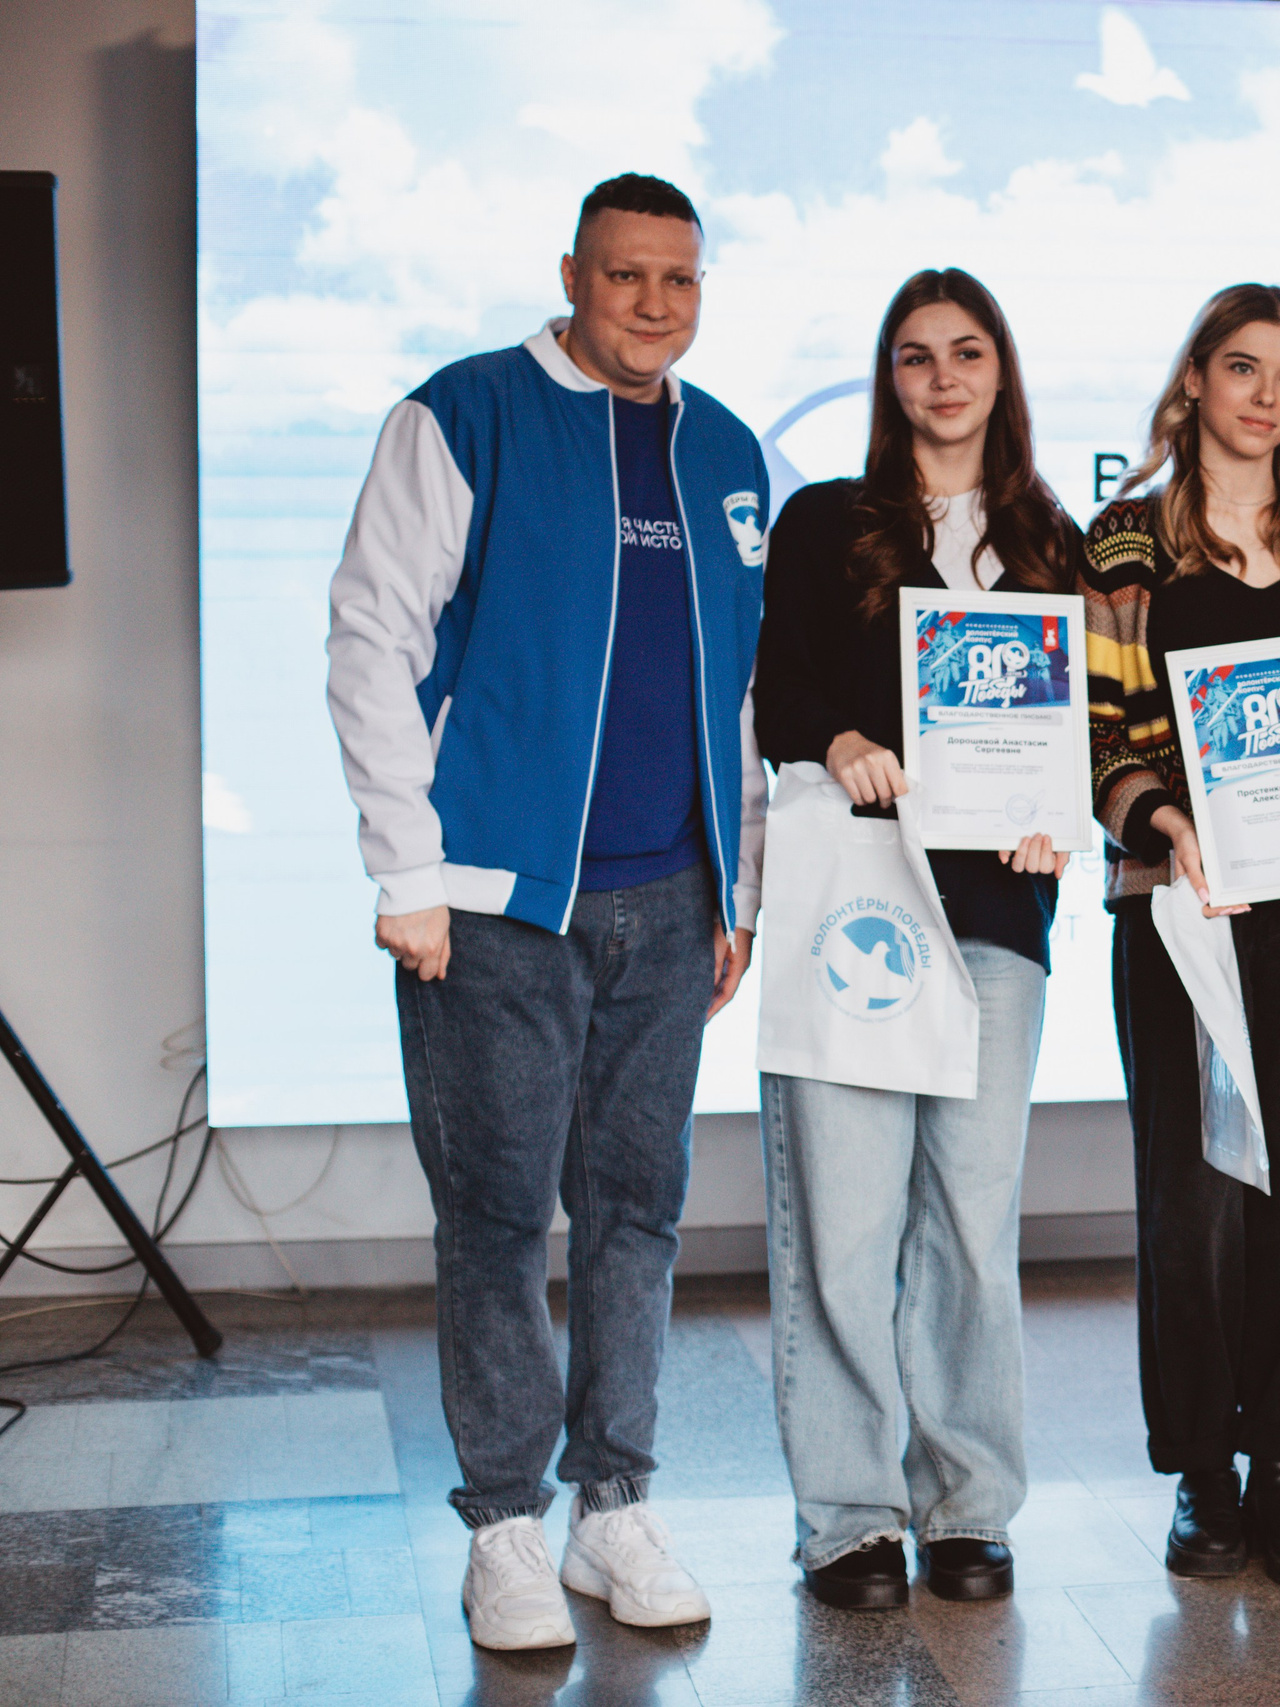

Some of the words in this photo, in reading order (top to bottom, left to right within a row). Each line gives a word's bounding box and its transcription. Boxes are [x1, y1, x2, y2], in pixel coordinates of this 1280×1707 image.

[621, 516, 632, 530] Я
[947, 736, 999, 746] Дорошевой
[1002, 738, 1048, 747] Анастасии
[974, 746, 1021, 755] Сергеевне
[811, 896, 890, 957] ВОЛОНТЁРЫ
[891, 904, 932, 969] ПОБЕДЫ
